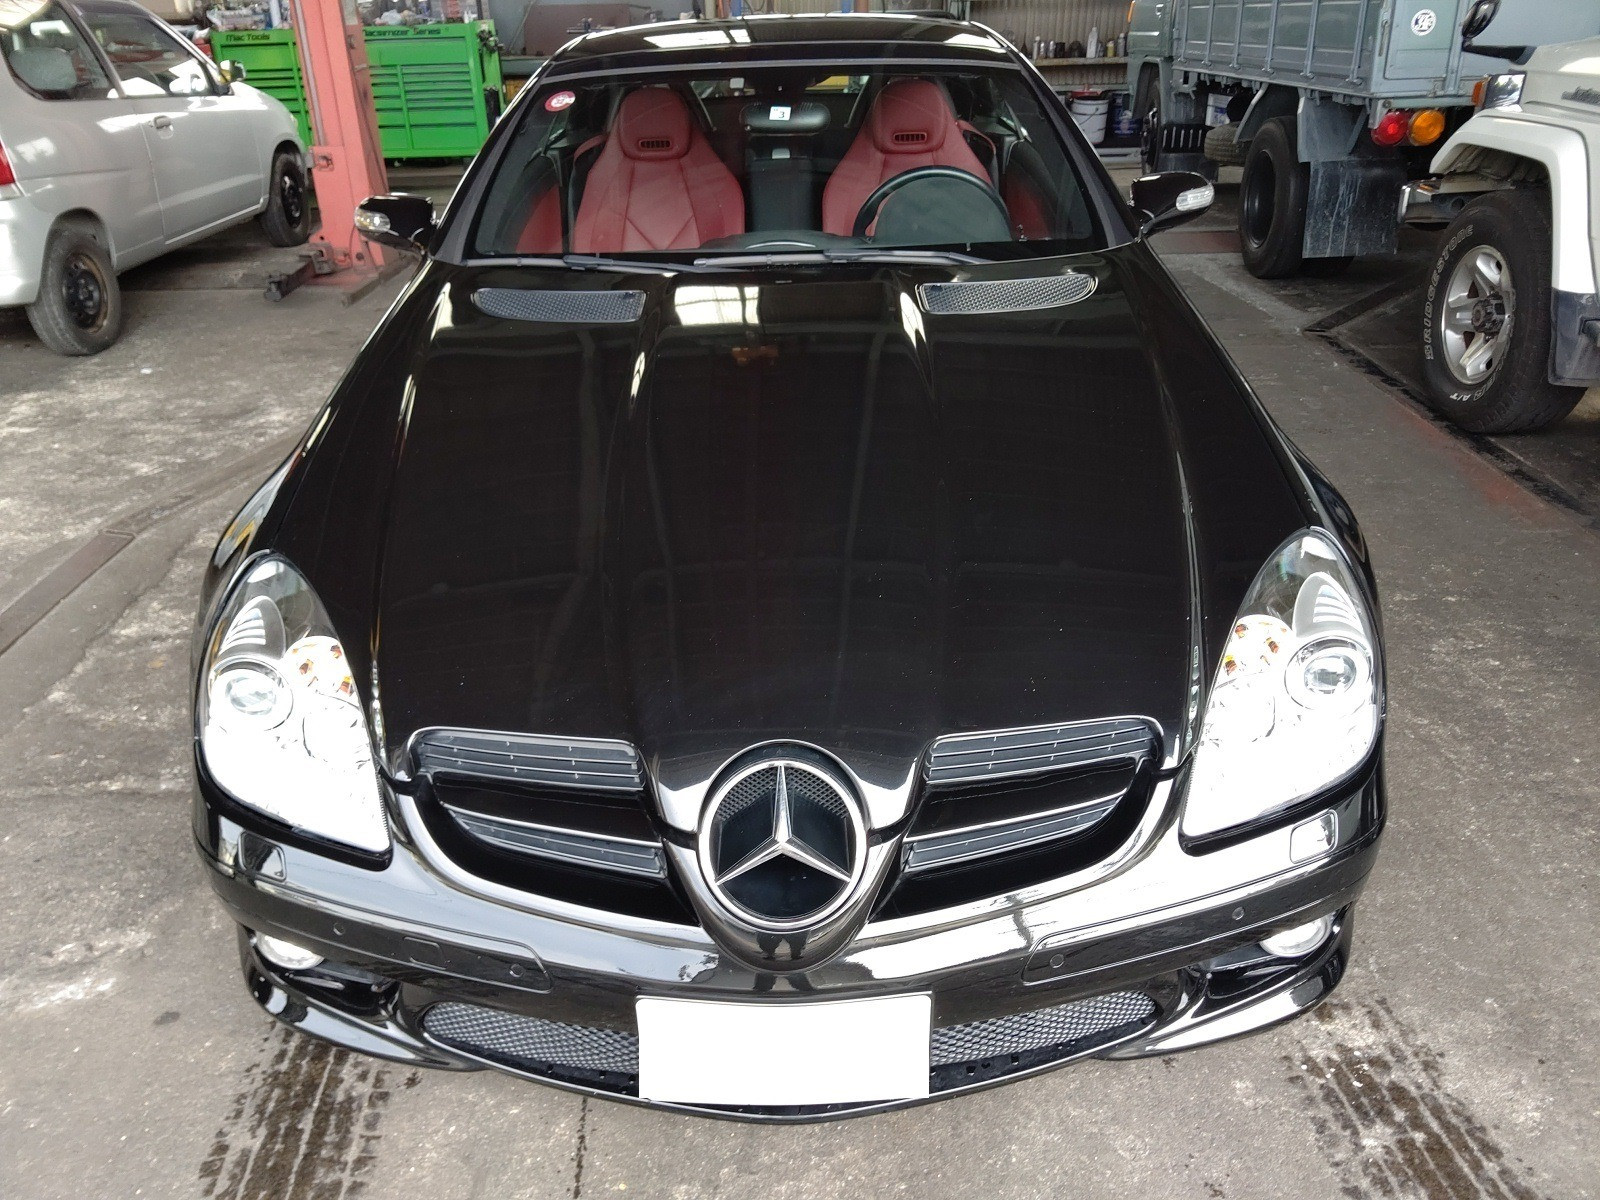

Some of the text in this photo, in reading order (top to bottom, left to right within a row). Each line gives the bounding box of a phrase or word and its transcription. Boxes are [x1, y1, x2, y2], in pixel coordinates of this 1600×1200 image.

[226, 33, 270, 42] Mac Tools
[1423, 224, 1474, 360] BRIDGESTONE
